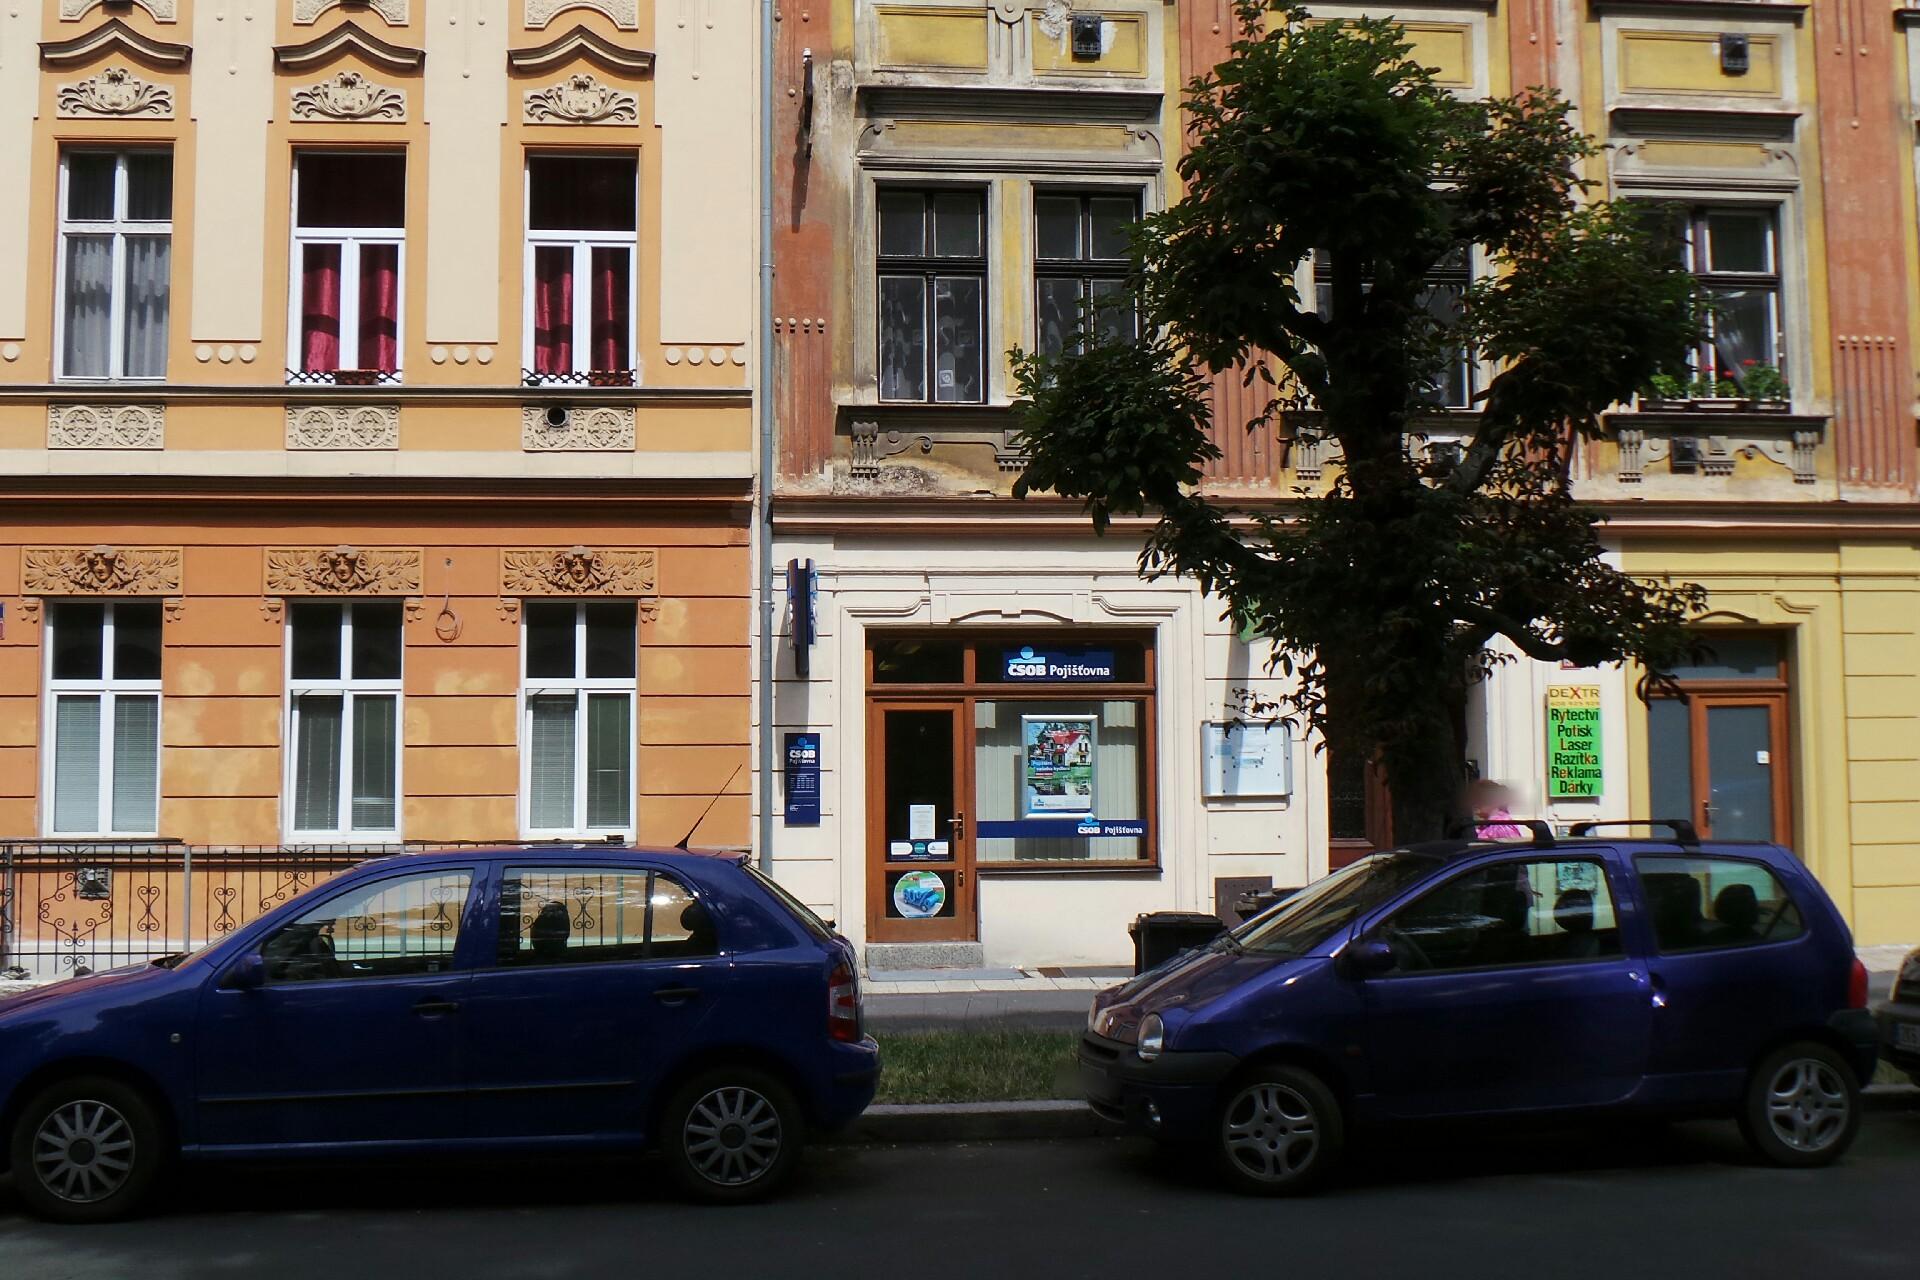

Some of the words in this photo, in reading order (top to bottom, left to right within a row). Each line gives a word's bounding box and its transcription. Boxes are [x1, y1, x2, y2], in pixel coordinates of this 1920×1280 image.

[1008, 663, 1047, 676] ČSOB
[1049, 664, 1110, 679] Pojišťovna
[1551, 708, 1600, 724] Rytectví
[1557, 724, 1593, 738] Potisk
[1560, 738, 1593, 751] Laser
[1551, 766, 1602, 778] Reklama
[1559, 780, 1594, 795] Dárky
[1104, 826, 1143, 836] Pojišťovna
